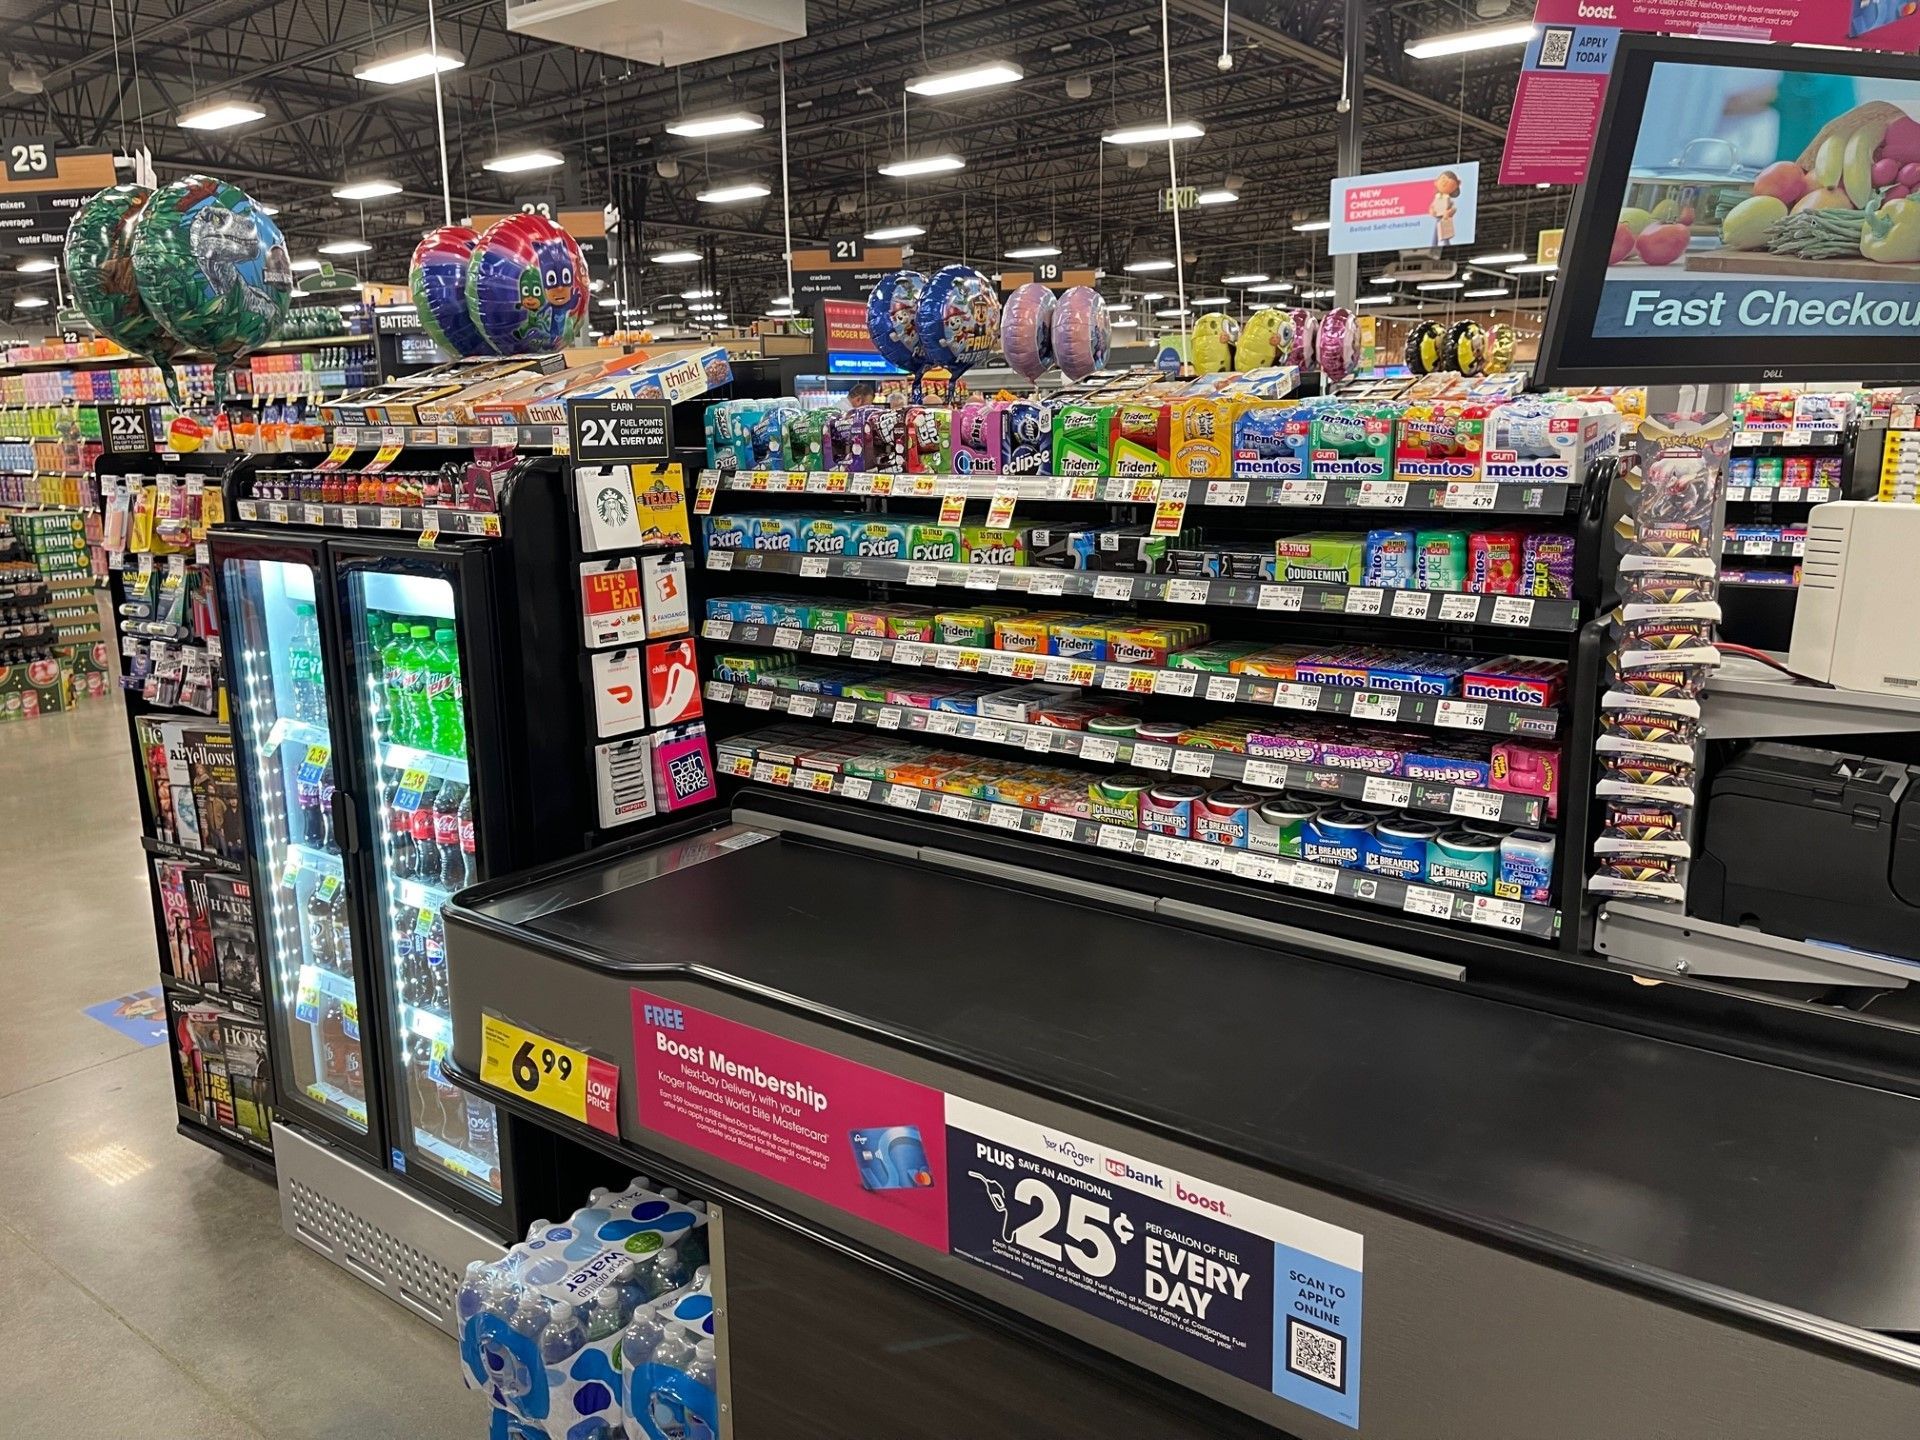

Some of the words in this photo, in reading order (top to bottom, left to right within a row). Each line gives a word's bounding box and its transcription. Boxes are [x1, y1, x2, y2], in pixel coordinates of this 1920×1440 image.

[1578, 36, 1608, 48] APPLY
[1576, 51, 1608, 64] TODAY
[11, 145, 48, 172] 25
[1166, 190, 1194, 210] EXIT
[1350, 191, 1358, 200] A
[1360, 189, 1382, 199] NEW
[52, 198, 79, 208] energy
[1350, 197, 1399, 210] CHECKOUT
[1350, 206, 1405, 220] EXPERIENCE
[17, 235, 41, 244] water
[41, 233, 64, 242] filters
[836, 240, 857, 258] 21
[1039, 264, 1057, 279] 19
[1624, 289, 1726, 327] Fast
[63, 331, 78, 343] 22
[830, 330, 859, 339] KROGER
[665, 364, 701, 388] think!
[1763, 369, 1784, 379] DELL
[529, 405, 564, 423] think!
[611, 403, 633, 411] EARN
[110, 414, 144, 434] 2X
[620, 419, 638, 427] FUEL
[639, 418, 664, 427] POINTS
[1285, 421, 1301, 431] 50
[1552, 420, 1568, 431] 50
[580, 419, 620, 447] 2X
[644, 427, 664, 435] CARDS
[620, 437, 647, 446] EVERY
[953, 450, 998, 475] Orbit
[1001, 449, 1051, 476] eclipse
[1315, 451, 1337, 460] GUM
[1490, 452, 1515, 462] GUM
[1060, 458, 1100, 472] Trident
[1117, 460, 1158, 473] Trident
[1187, 458, 1208, 468] Juicy
[1234, 459, 1302, 475] mentos
[1312, 459, 1384, 475] mentos
[1399, 461, 1474, 477] mentos
[1486, 462, 1569, 478] mentos
[829, 477, 844, 486] 3.79
[643, 492, 679, 505] TEXAS
[1172, 489, 1187, 499] 4.49
[1304, 493, 1322, 502] 4.79
[1384, 495, 1403, 505] 4.79
[1158, 501, 1184, 512] 2.99
[1472, 498, 1493, 507] 4.79
[43, 515, 72, 528] mini
[45, 534, 74, 547] mini
[709, 530, 743, 548] Extra
[1035, 531, 1046, 539] 35
[1641, 528, 1665, 539] LOST
[1665, 528, 1700, 543] ORIGIN
[806, 534, 844, 553] Extra
[912, 542, 954, 562] Extra
[970, 545, 1016, 565] Extra
[1287, 566, 1348, 582] DOUBLEMINT
[1534, 562, 1548, 597] SOUR
[593, 573, 626, 593] LET'S
[611, 588, 638, 610] EAT
[1190, 592, 1207, 601] 2.19
[1283, 599, 1301, 608] 4.19
[657, 610, 687, 621] FANDANGO
[1455, 610, 1475, 620] 2.69
[1510, 614, 1530, 625] 2.99
[1000, 633, 1037, 647] Trident
[1112, 643, 1154, 659] Trident
[1014, 664, 1034, 674] 2/5.00
[1070, 669, 1092, 680] 2/5.00
[1220, 692, 1235, 700] 1.69
[1466, 684, 1543, 704] mentos
[1300, 698, 1317, 708] 1.59
[1379, 707, 1397, 717] 1.59
[1465, 715, 1484, 726] 1.59
[1250, 746, 1312, 761] Bubble
[669, 755, 703, 778] Bath
[1323, 754, 1393, 771] Bubble
[1268, 776, 1284, 786] 1.49
[1408, 765, 1479, 783] Bubble
[676, 777, 709, 797] Works
[1390, 792, 1409, 803] 1.69
[621, 801, 648, 814] CHIPOTLE
[1007, 819, 1020, 828] 1.79
[1614, 811, 1639, 825] LOST
[1639, 812, 1674, 827] ORIGIN
[1206, 831, 1233, 845] DUO
[1204, 857, 1220, 866] 3.29
[1319, 856, 1344, 867] MINTS
[1365, 851, 1379, 866] ICE
[1379, 854, 1420, 874] BREAKERS
[1430, 863, 1444, 877] ICE
[1444, 866, 1488, 885] BREAKERS
[1511, 870, 1534, 881] Clean
[1446, 879, 1472, 890] MINTS
[1508, 876, 1540, 888] Breath
[1497, 884, 1519, 895] 150
[1501, 914, 1521, 926] 4.29
[644, 1004, 685, 1031] FREE
[656, 1031, 705, 1067] Boost
[709, 1049, 828, 1112] Membership
[587, 1080, 612, 1100] LOW
[658, 1069, 685, 1088] Kroger
[686, 1080, 724, 1104] Rewards
[724, 1095, 751, 1114] World
[752, 1105, 771, 1122] Elite
[681, 1063, 720, 1089] Next-Day
[721, 1078, 757, 1102] Delivery,
[759, 1093, 778, 1110] with
[780, 1102, 801, 1118] your
[587, 1094, 611, 1112] PRICE
[976, 1142, 1015, 1170] PLUS
[1018, 1157, 1041, 1175] SAVE
[1041, 1166, 1055, 1179] AN
[1057, 1172, 1113, 1201] ADDITIONAL
[1145, 1221, 1163, 1236] PER
[1163, 1225, 1202, 1251] GALLON
[1203, 1243, 1217, 1256] OF
[1218, 1248, 1241, 1266] FUEL
[565, 1250, 625, 1293] water
[1145, 1235, 1251, 1302] EVERY
[1289, 1270, 1325, 1291] SCAN
[1327, 1284, 1346, 1299] TO
[1145, 1268, 1213, 1321] DAY
[1298, 1288, 1337, 1310] APPLY
[1293, 1301, 1341, 1326] ONLINE
